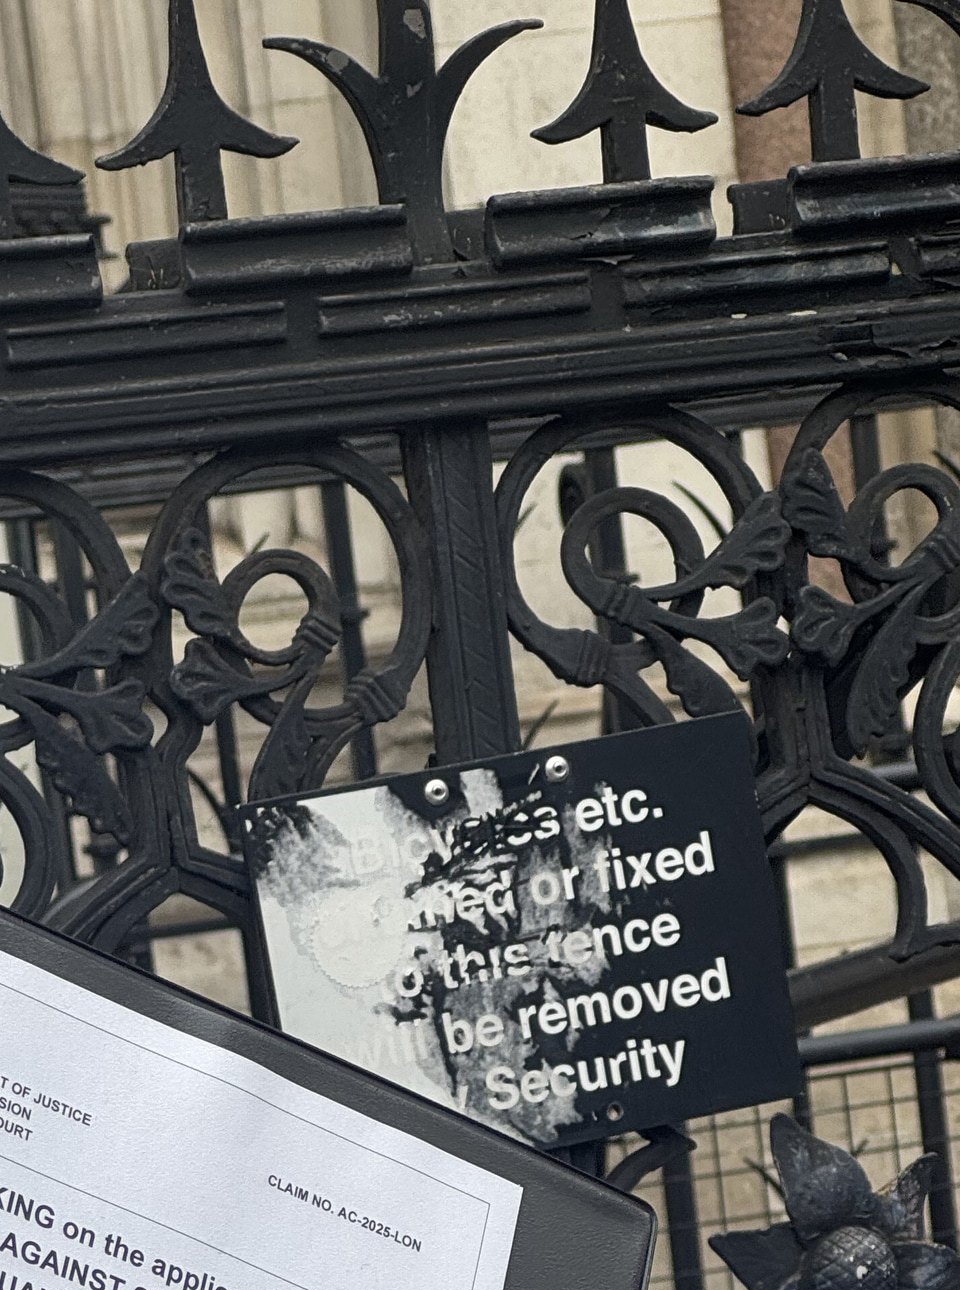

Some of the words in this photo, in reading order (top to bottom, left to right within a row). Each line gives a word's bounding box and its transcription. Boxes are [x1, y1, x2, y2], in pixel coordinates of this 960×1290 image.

[574, 786, 664, 832] etc.
[530, 865, 580, 906] or
[594, 830, 715, 893] fixed
[440, 943, 532, 989] this
[441, 1011, 506, 1056] be
[517, 956, 731, 1040] removed
[12, 1083, 31, 1097] OF
[34, 1093, 92, 1126] JUSTICE
[485, 1038, 687, 1111] Security
[268, 1175, 309, 1202] CLAIM
[312, 1194, 333, 1214] NO.
[337, 1207, 421, 1252] AC-2025-LON
[62, 1221, 96, 1249] on
[104, 1233, 145, 1268] the
